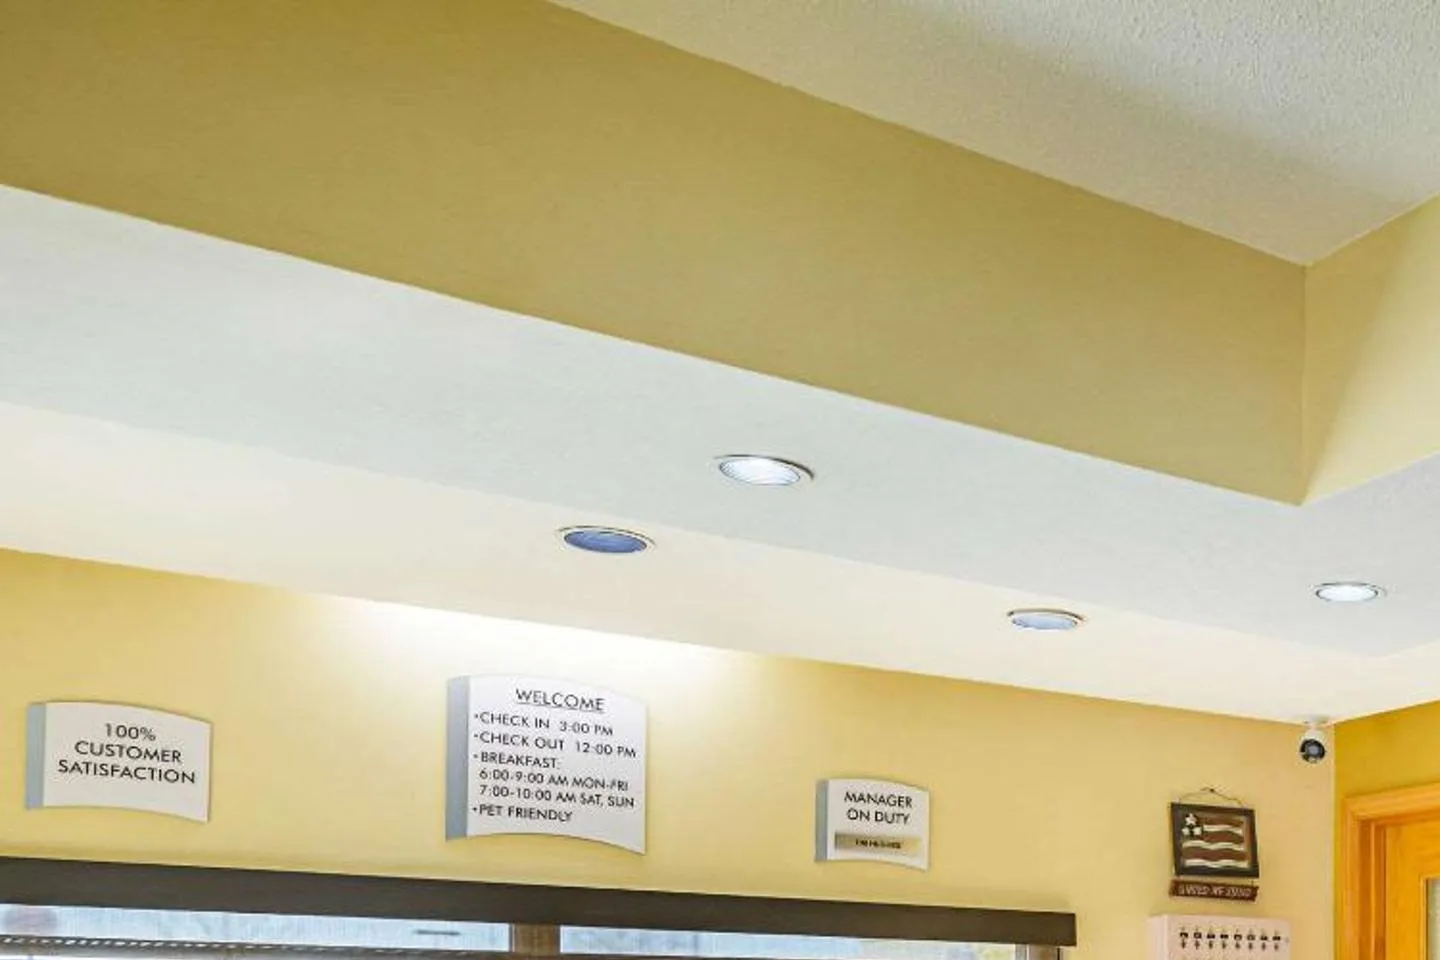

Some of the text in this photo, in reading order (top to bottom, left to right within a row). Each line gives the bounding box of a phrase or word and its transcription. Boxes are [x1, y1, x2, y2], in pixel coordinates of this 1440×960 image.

[515, 688, 606, 712] WELCOME
[103, 723, 156, 742] 100%
[480, 712, 613, 736] CHECK IN 3:00 PM
[74, 740, 182, 764] CUSTOMER
[480, 732, 636, 758] CHECK OUT 12:00 PM
[58, 759, 196, 784] SATISFACTION
[547, 775, 569, 787] AM
[556, 791, 577, 804] AM
[607, 796, 635, 809] SUN
[843, 791, 913, 808] MANAGER
[479, 804, 573, 823] PET FRIENDLY
[846, 808, 911, 825] ON DUTY
